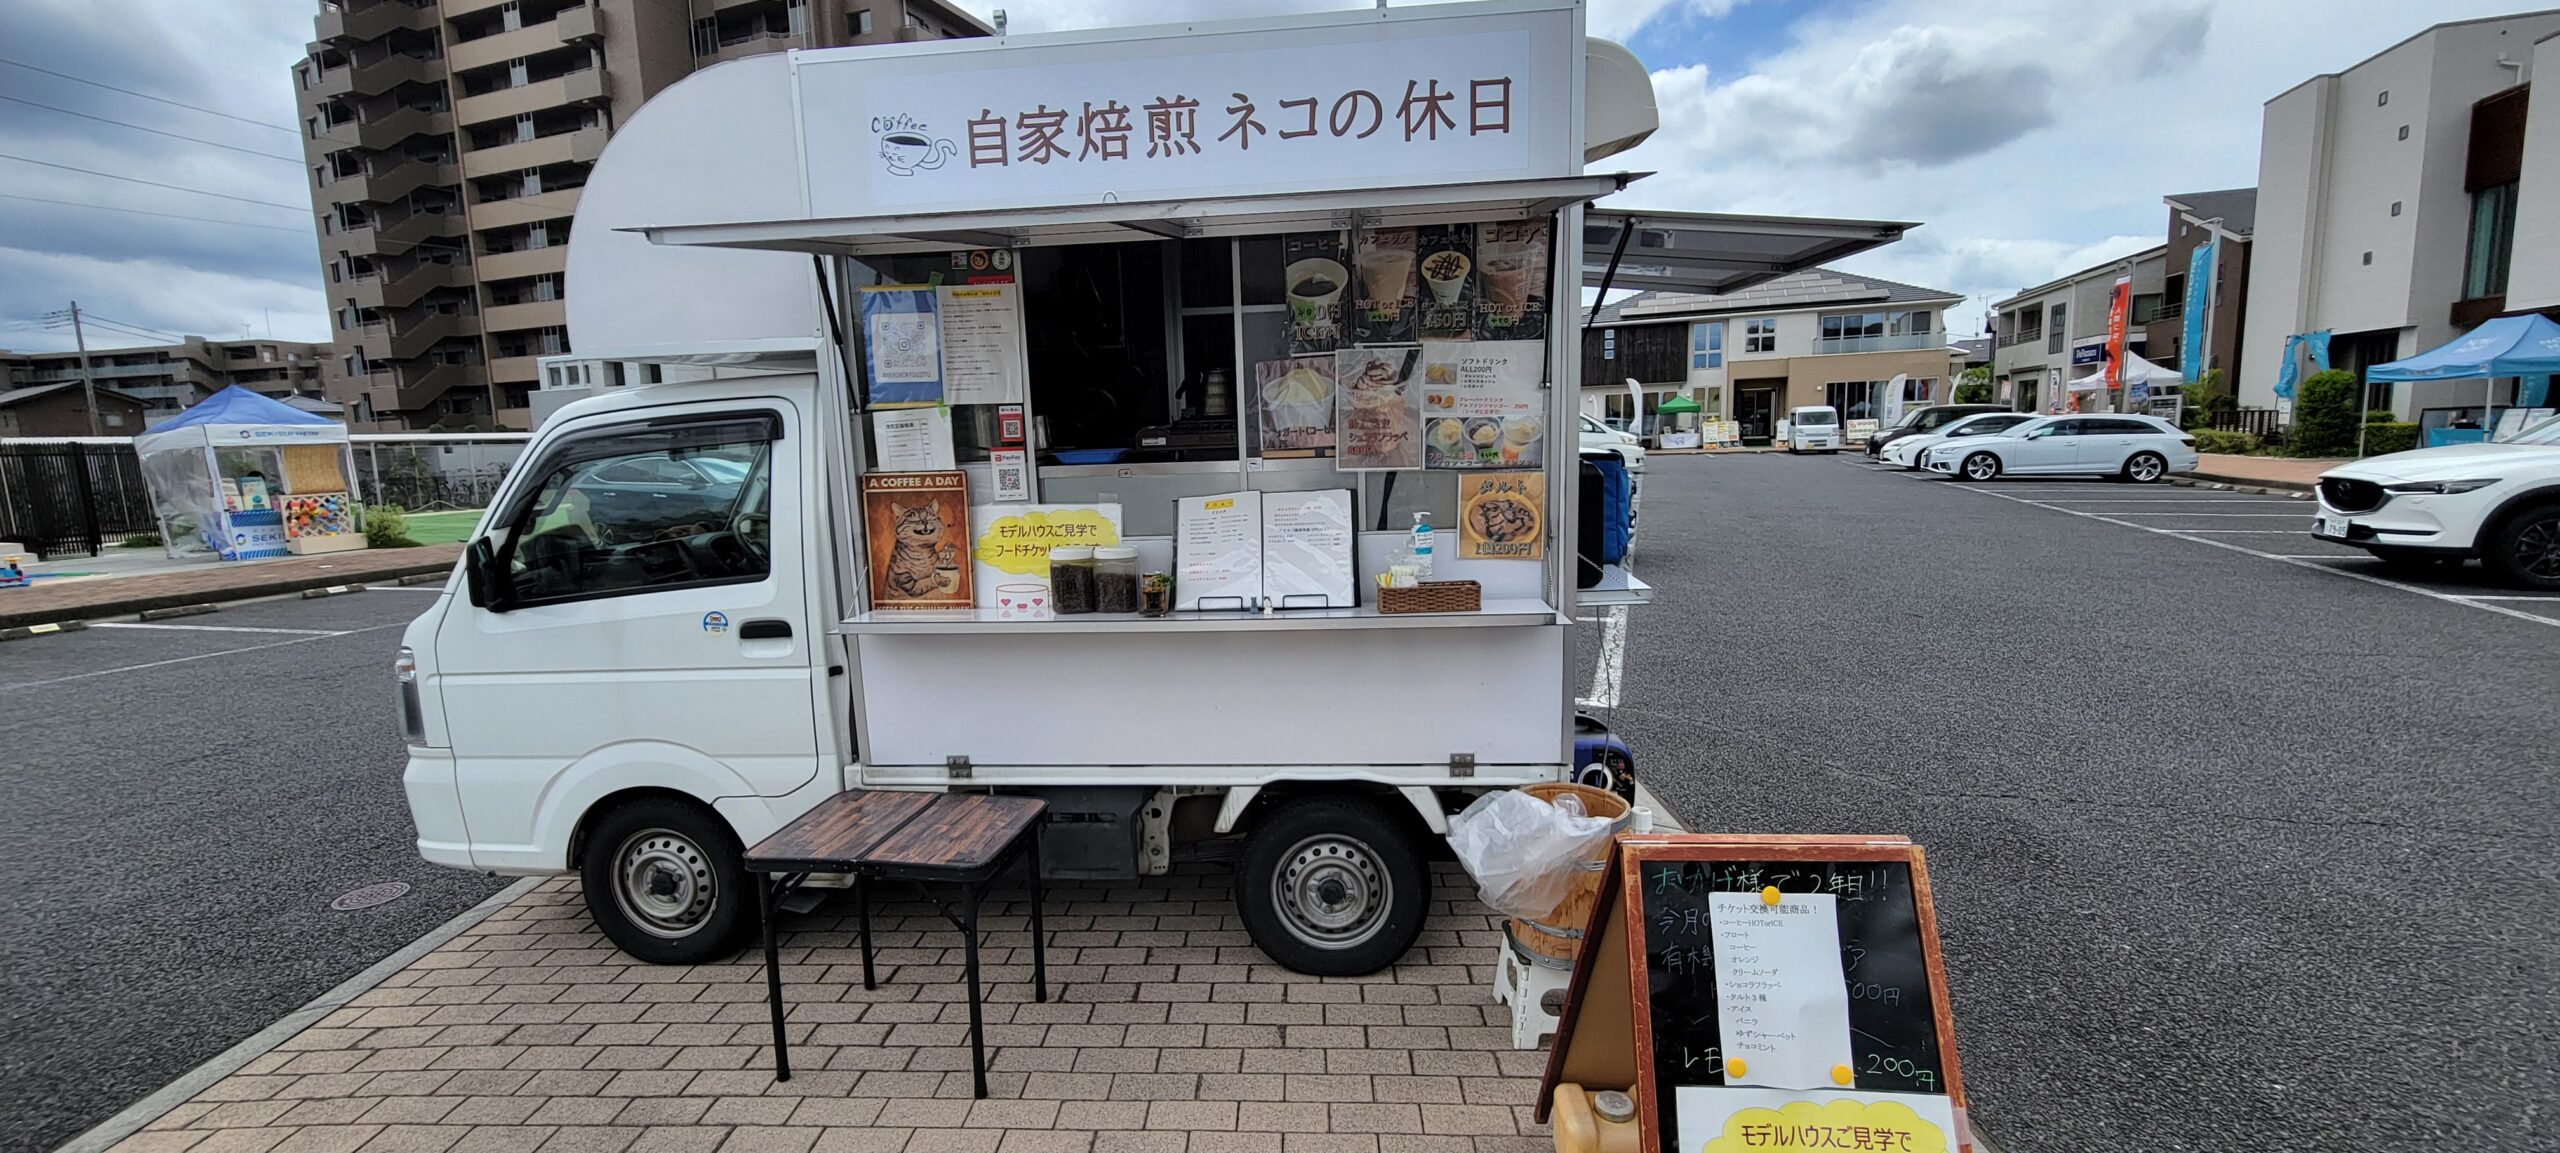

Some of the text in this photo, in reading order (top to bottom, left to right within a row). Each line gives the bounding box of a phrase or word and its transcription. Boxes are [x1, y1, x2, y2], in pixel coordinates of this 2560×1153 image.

[966, 76, 1513, 169] 自家焙煎 ネコの休日
[869, 476, 959, 488] A COFFEE A DAY
[1480, 479, 1527, 495] タルト
[1000, 523, 1098, 538] モデルハウスご見学で
[1730, 955, 1760, 964] オレンジ
[1732, 968, 1779, 976] クリームソーダ
[1737, 1041, 1777, 1053] チョコミント
[1741, 1123, 1913, 1152] モデルハウスご見学で
